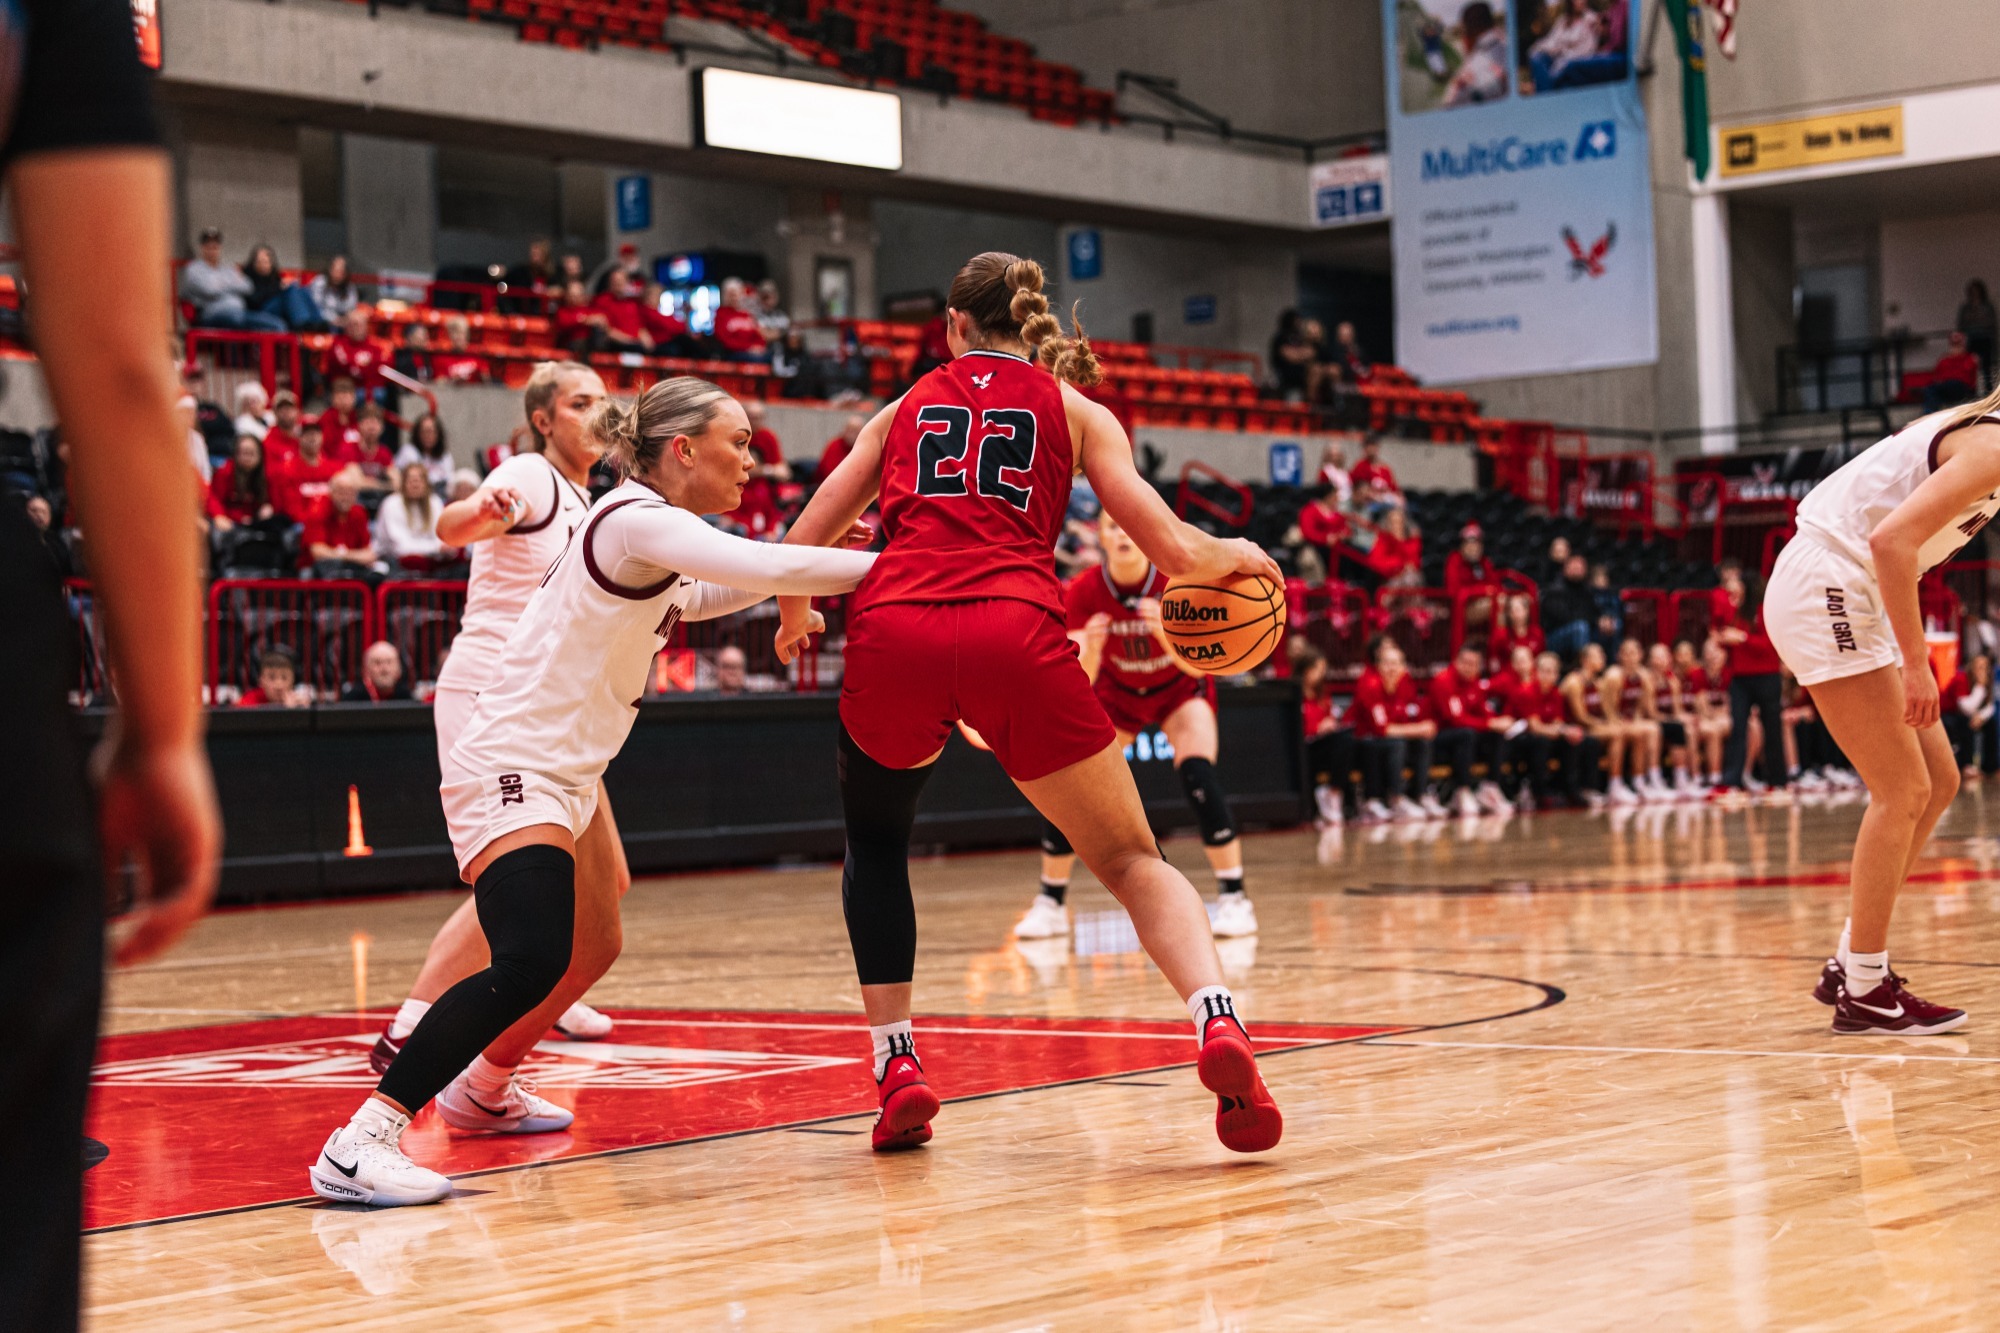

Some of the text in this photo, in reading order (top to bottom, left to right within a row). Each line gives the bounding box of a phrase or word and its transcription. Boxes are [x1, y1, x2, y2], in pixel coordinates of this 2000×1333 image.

[1420, 136, 1568, 182] MultiCare
[914, 404, 1037, 513] 22
[1162, 598, 1229, 621] Wilson
[1825, 587, 1857, 653] LADY GRIZ
[1122, 636, 1150, 661] 10
[1172, 642, 1227, 660] NCAA
